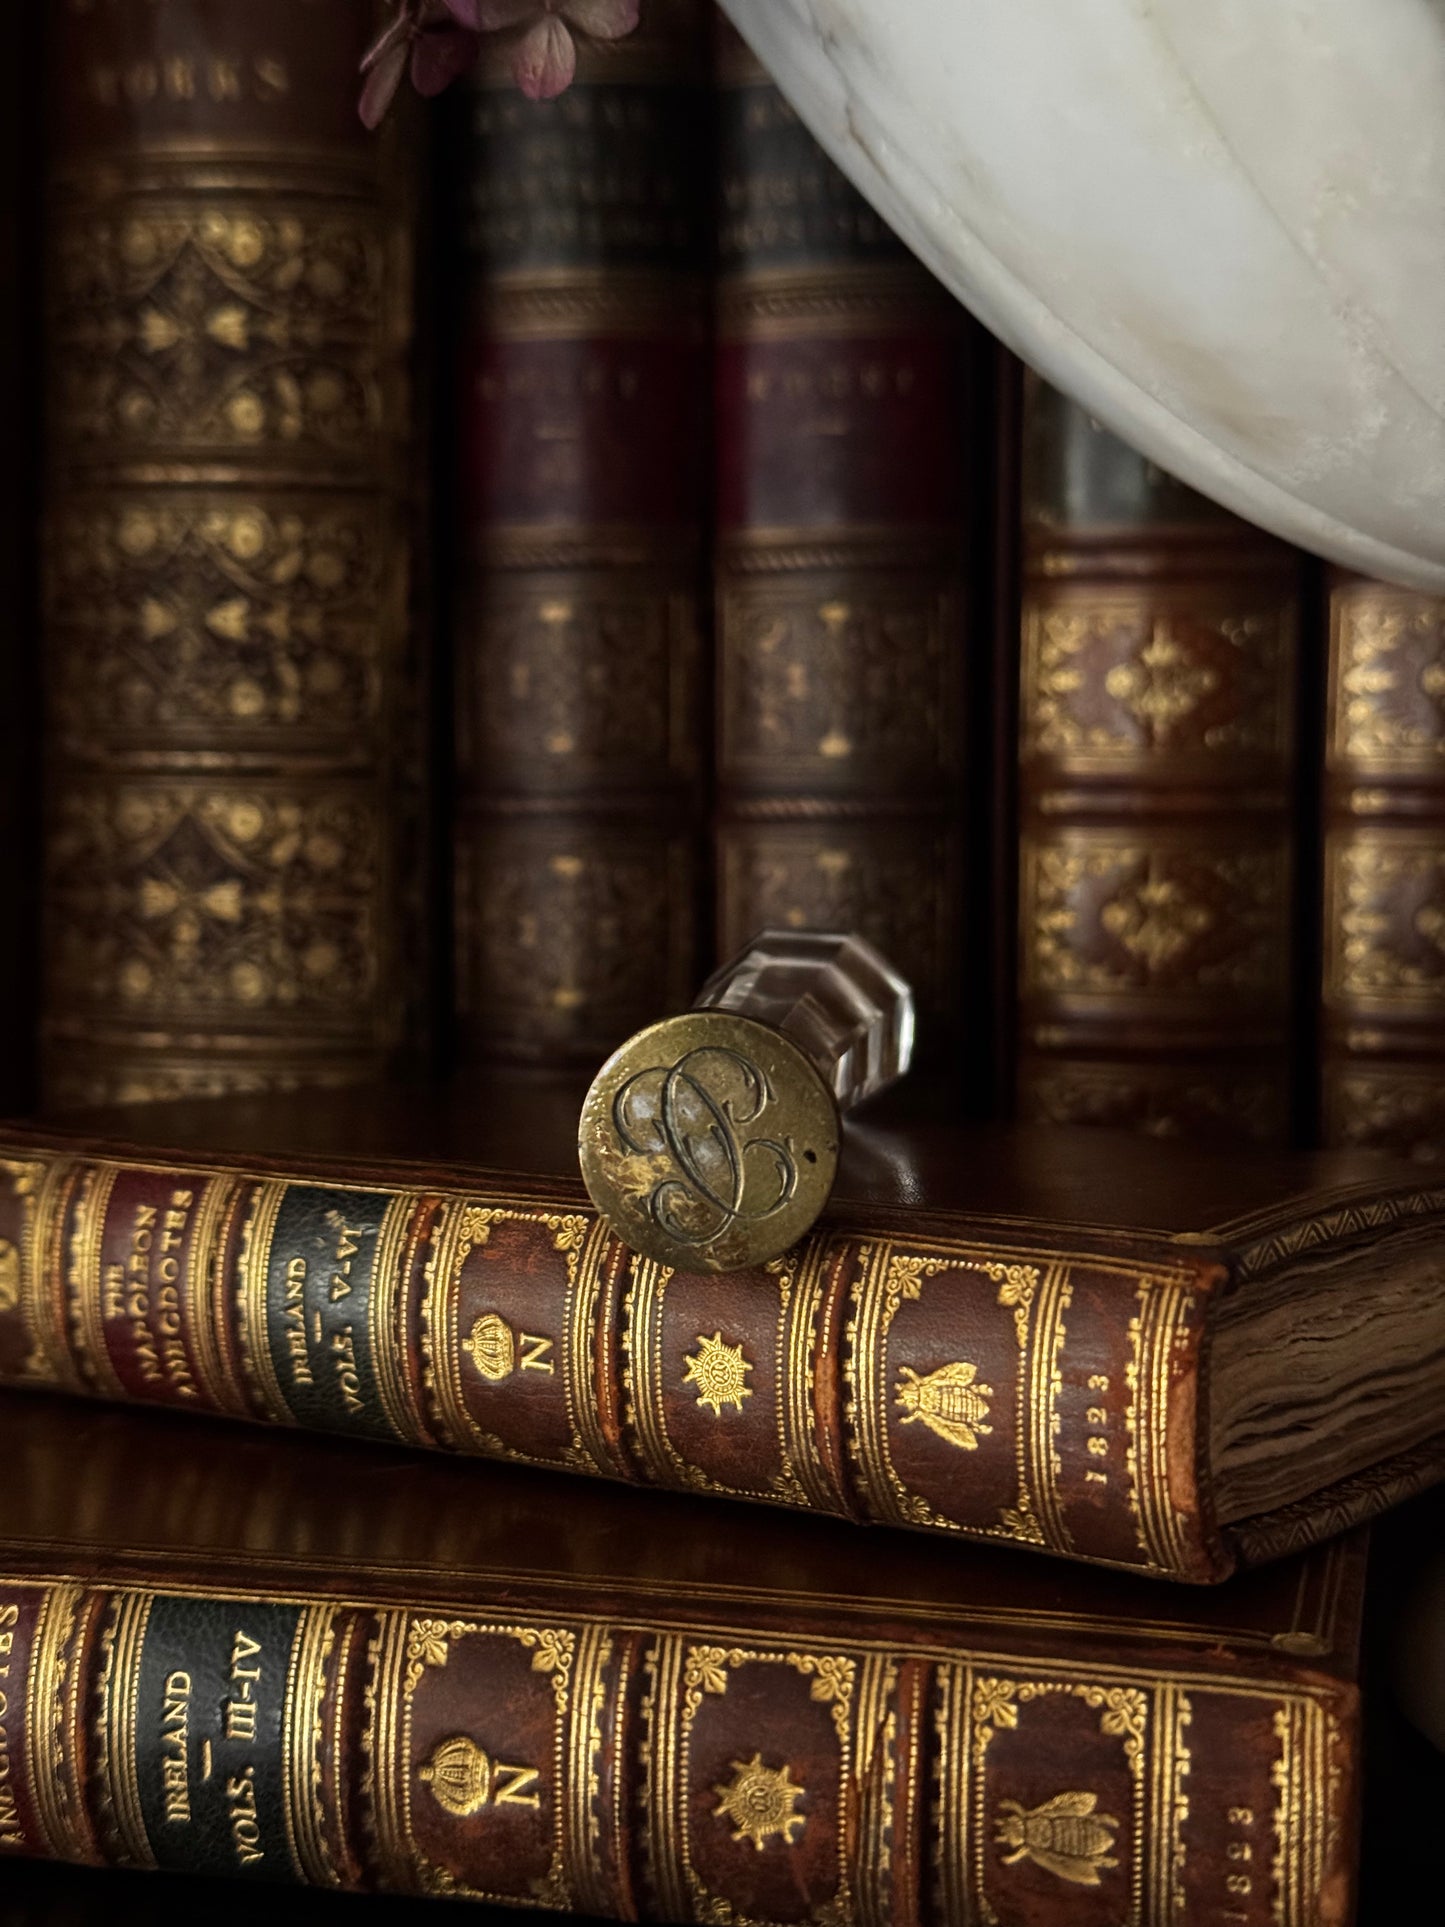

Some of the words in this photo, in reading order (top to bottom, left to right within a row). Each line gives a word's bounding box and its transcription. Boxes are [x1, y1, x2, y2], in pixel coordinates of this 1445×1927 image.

[104, 1264, 125, 1320] THE
[128, 1205, 162, 1382] NAPOLEON
[158, 1190, 198, 1399] ANECDOTES
[285, 1258, 314, 1384] IRELAND
[332, 1326, 365, 1414] VOLS.
[520, 1332, 554, 1375] N
[1085, 1375, 1109, 1485] 1823
[225, 1630, 262, 1742] III-IV
[163, 1670, 191, 1823] IRELAND
[494, 1760, 541, 1810] N
[226, 1767, 264, 1865] VOLS.
